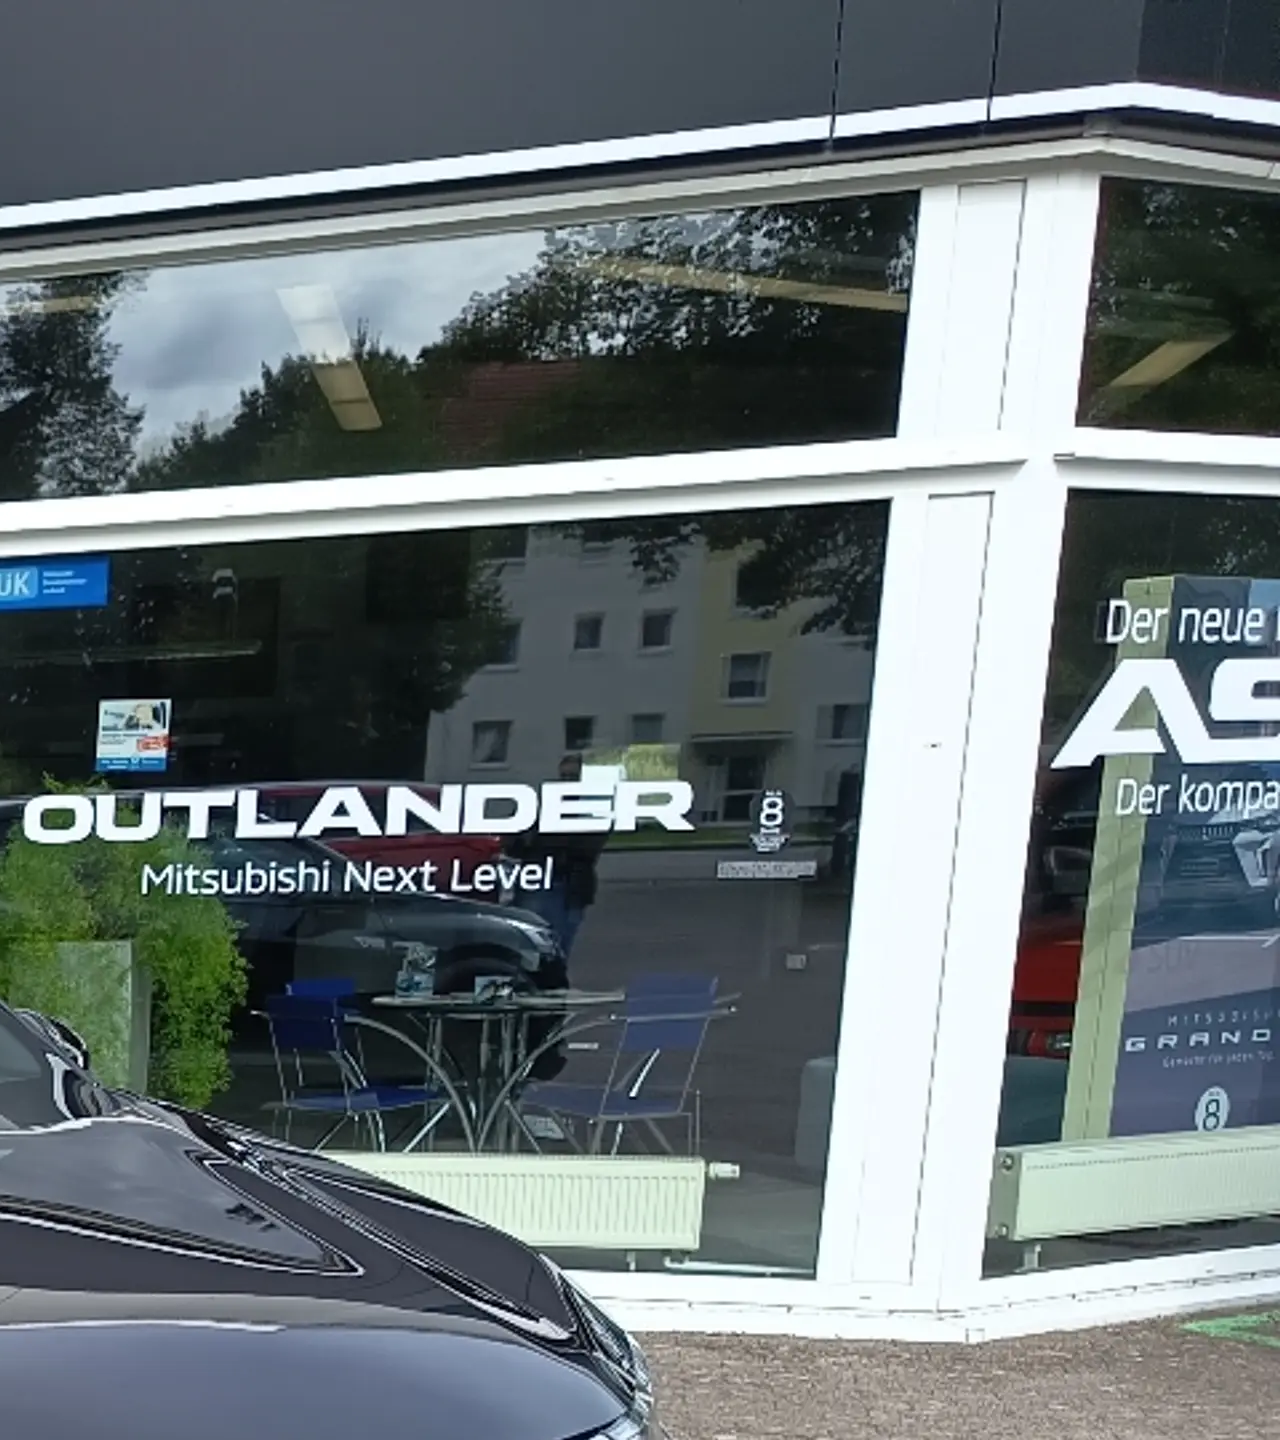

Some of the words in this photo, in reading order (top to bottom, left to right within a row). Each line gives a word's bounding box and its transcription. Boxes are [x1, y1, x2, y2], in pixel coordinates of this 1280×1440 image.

[1106, 598, 1169, 644] Der
[1178, 605, 1265, 643] neue
[22, 779, 695, 845] OUTLANDER
[760, 796, 784, 828] 8
[1115, 777, 1171, 816] Der
[140, 860, 331, 897] Mitsubishi
[342, 859, 438, 894] Next
[450, 856, 555, 892] Level
[1125, 1028, 1272, 1052] GRAND
